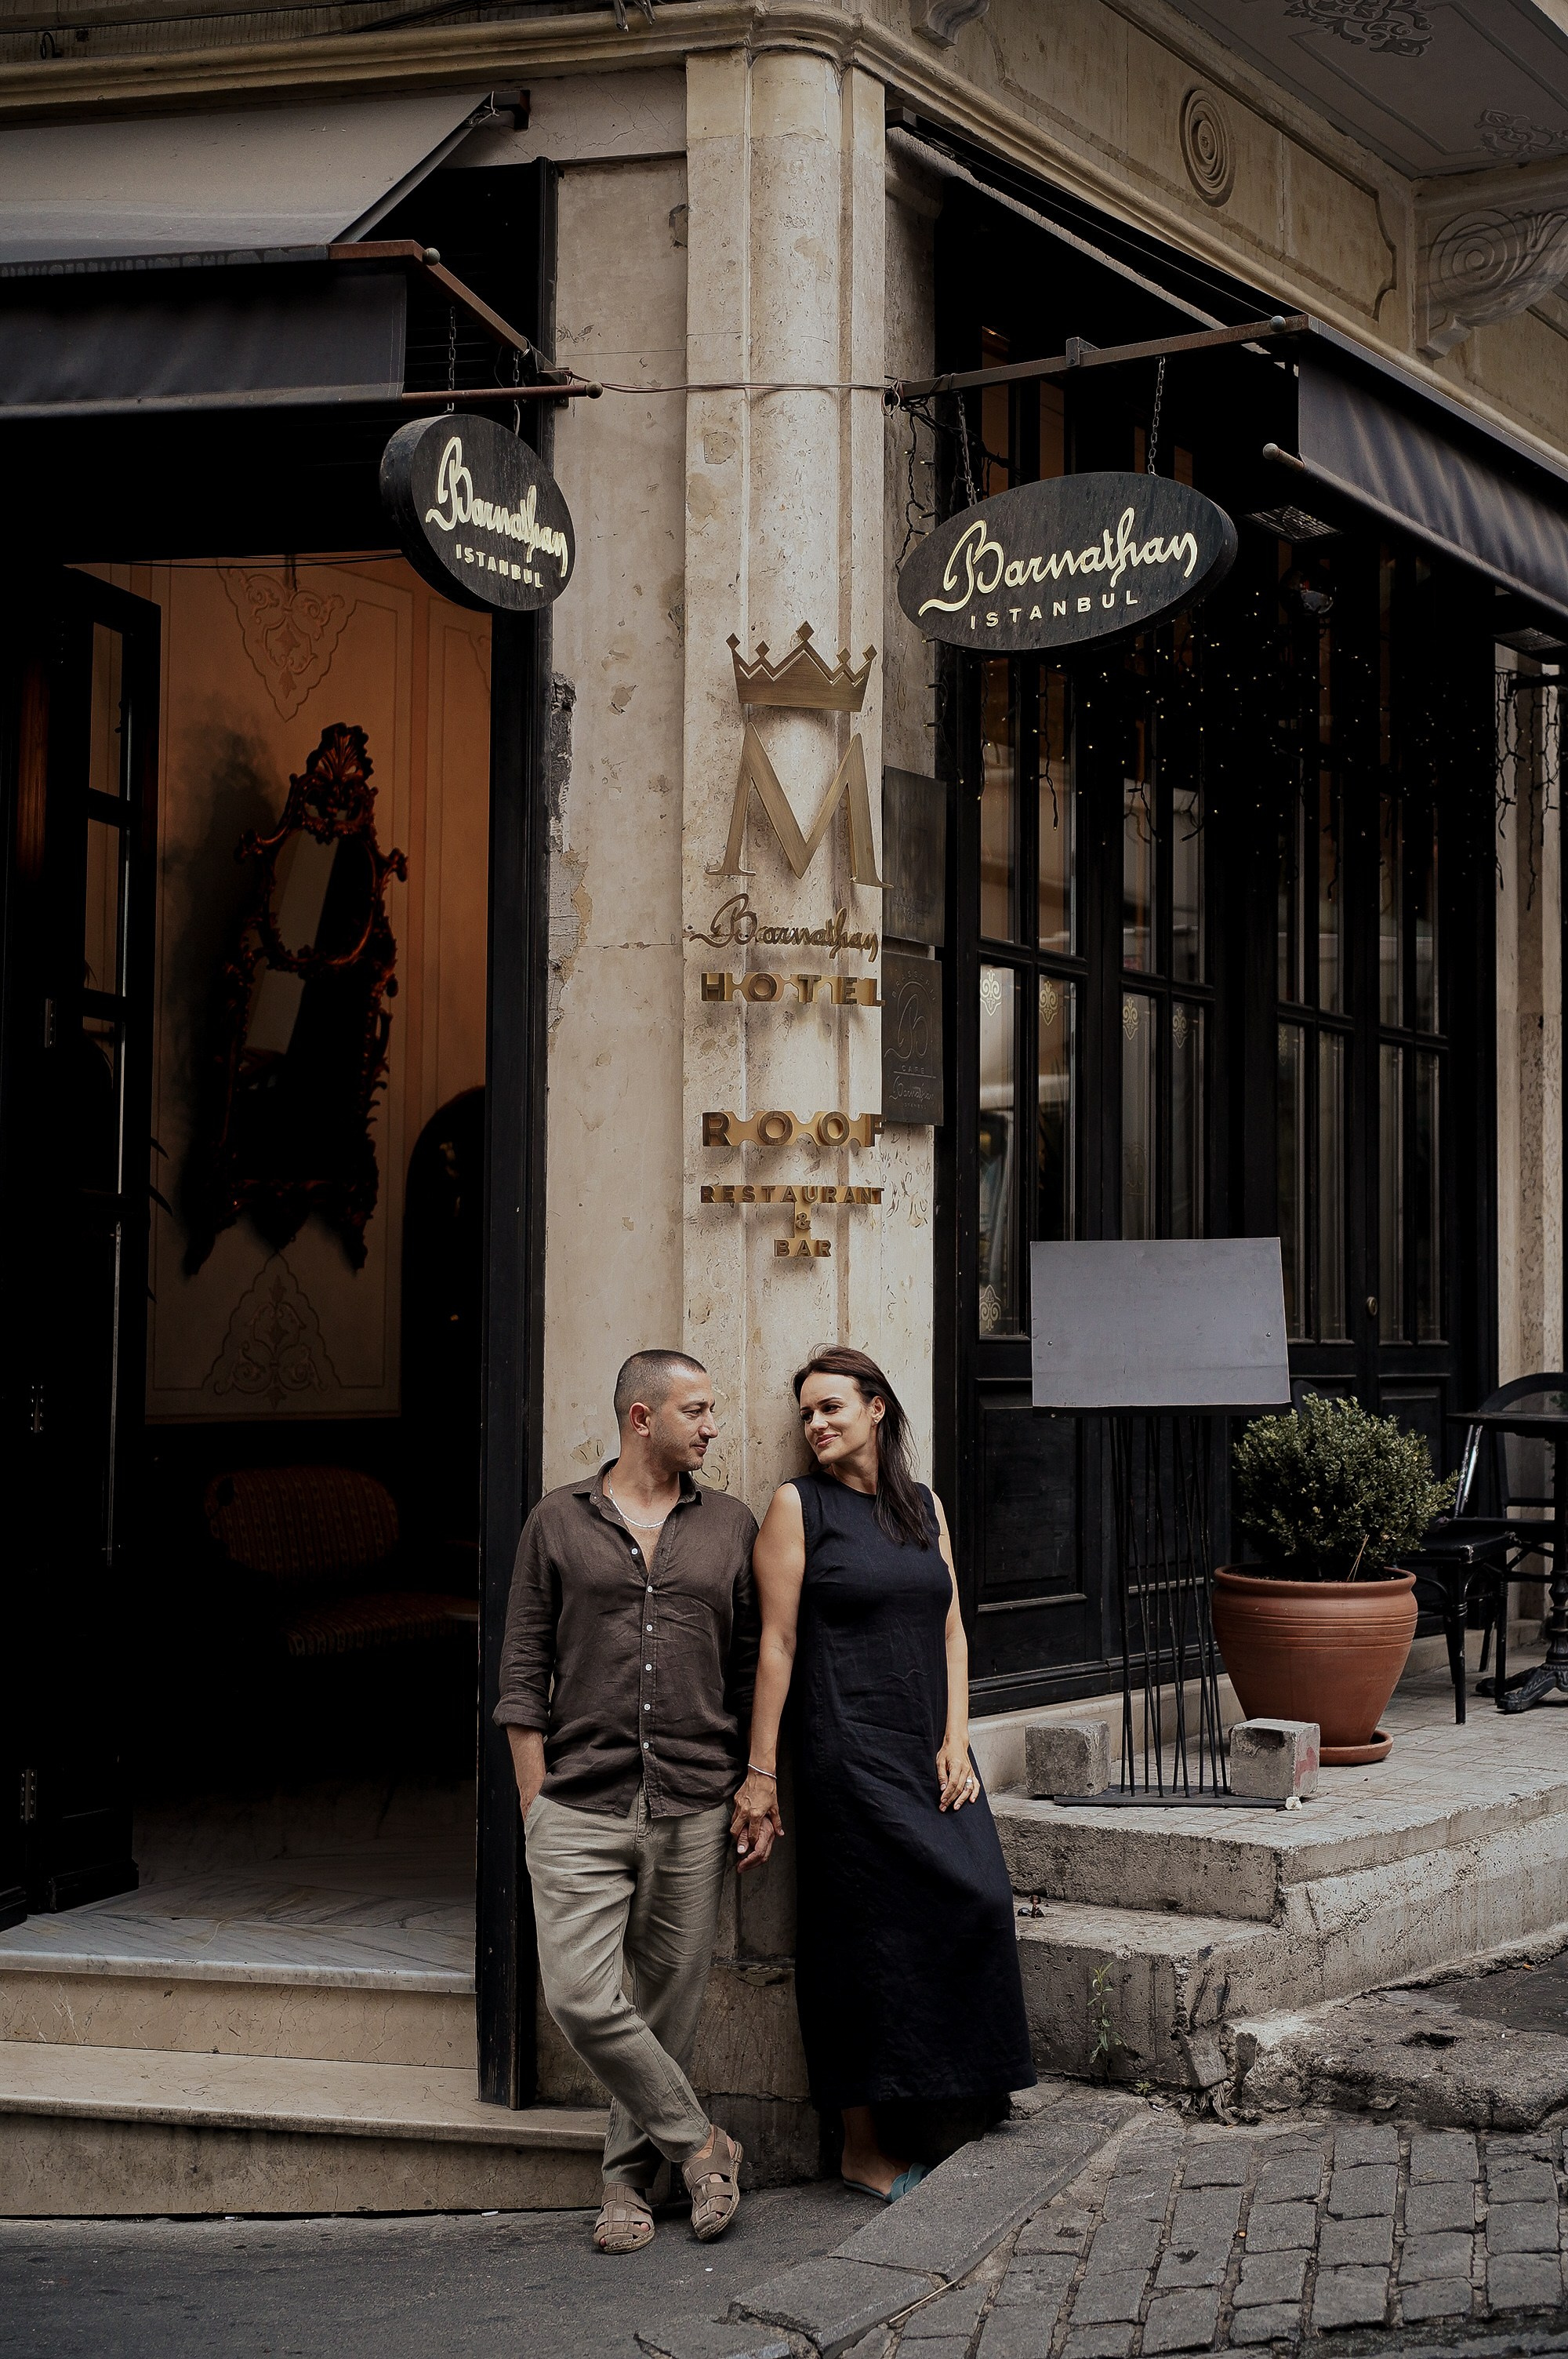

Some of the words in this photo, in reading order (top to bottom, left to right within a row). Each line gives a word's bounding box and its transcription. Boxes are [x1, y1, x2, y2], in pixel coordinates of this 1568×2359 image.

[426, 437, 568, 577] Barnathan
[456, 544, 543, 587] ISTANBUL
[918, 507, 1198, 616] Barnathan
[971, 590, 1138, 630] ISTANBUL
[706, 722, 894, 889] M
[689, 893, 879, 962] Barnathan
[701, 972, 885, 1007] HOTEL
[902, 1065, 925, 1074] CAFE
[702, 1110, 885, 1147] ROOF
[700, 1185, 885, 1205] RESTAURANT
[796, 1212, 812, 1230] &
[774, 1239, 832, 1257] BAR
